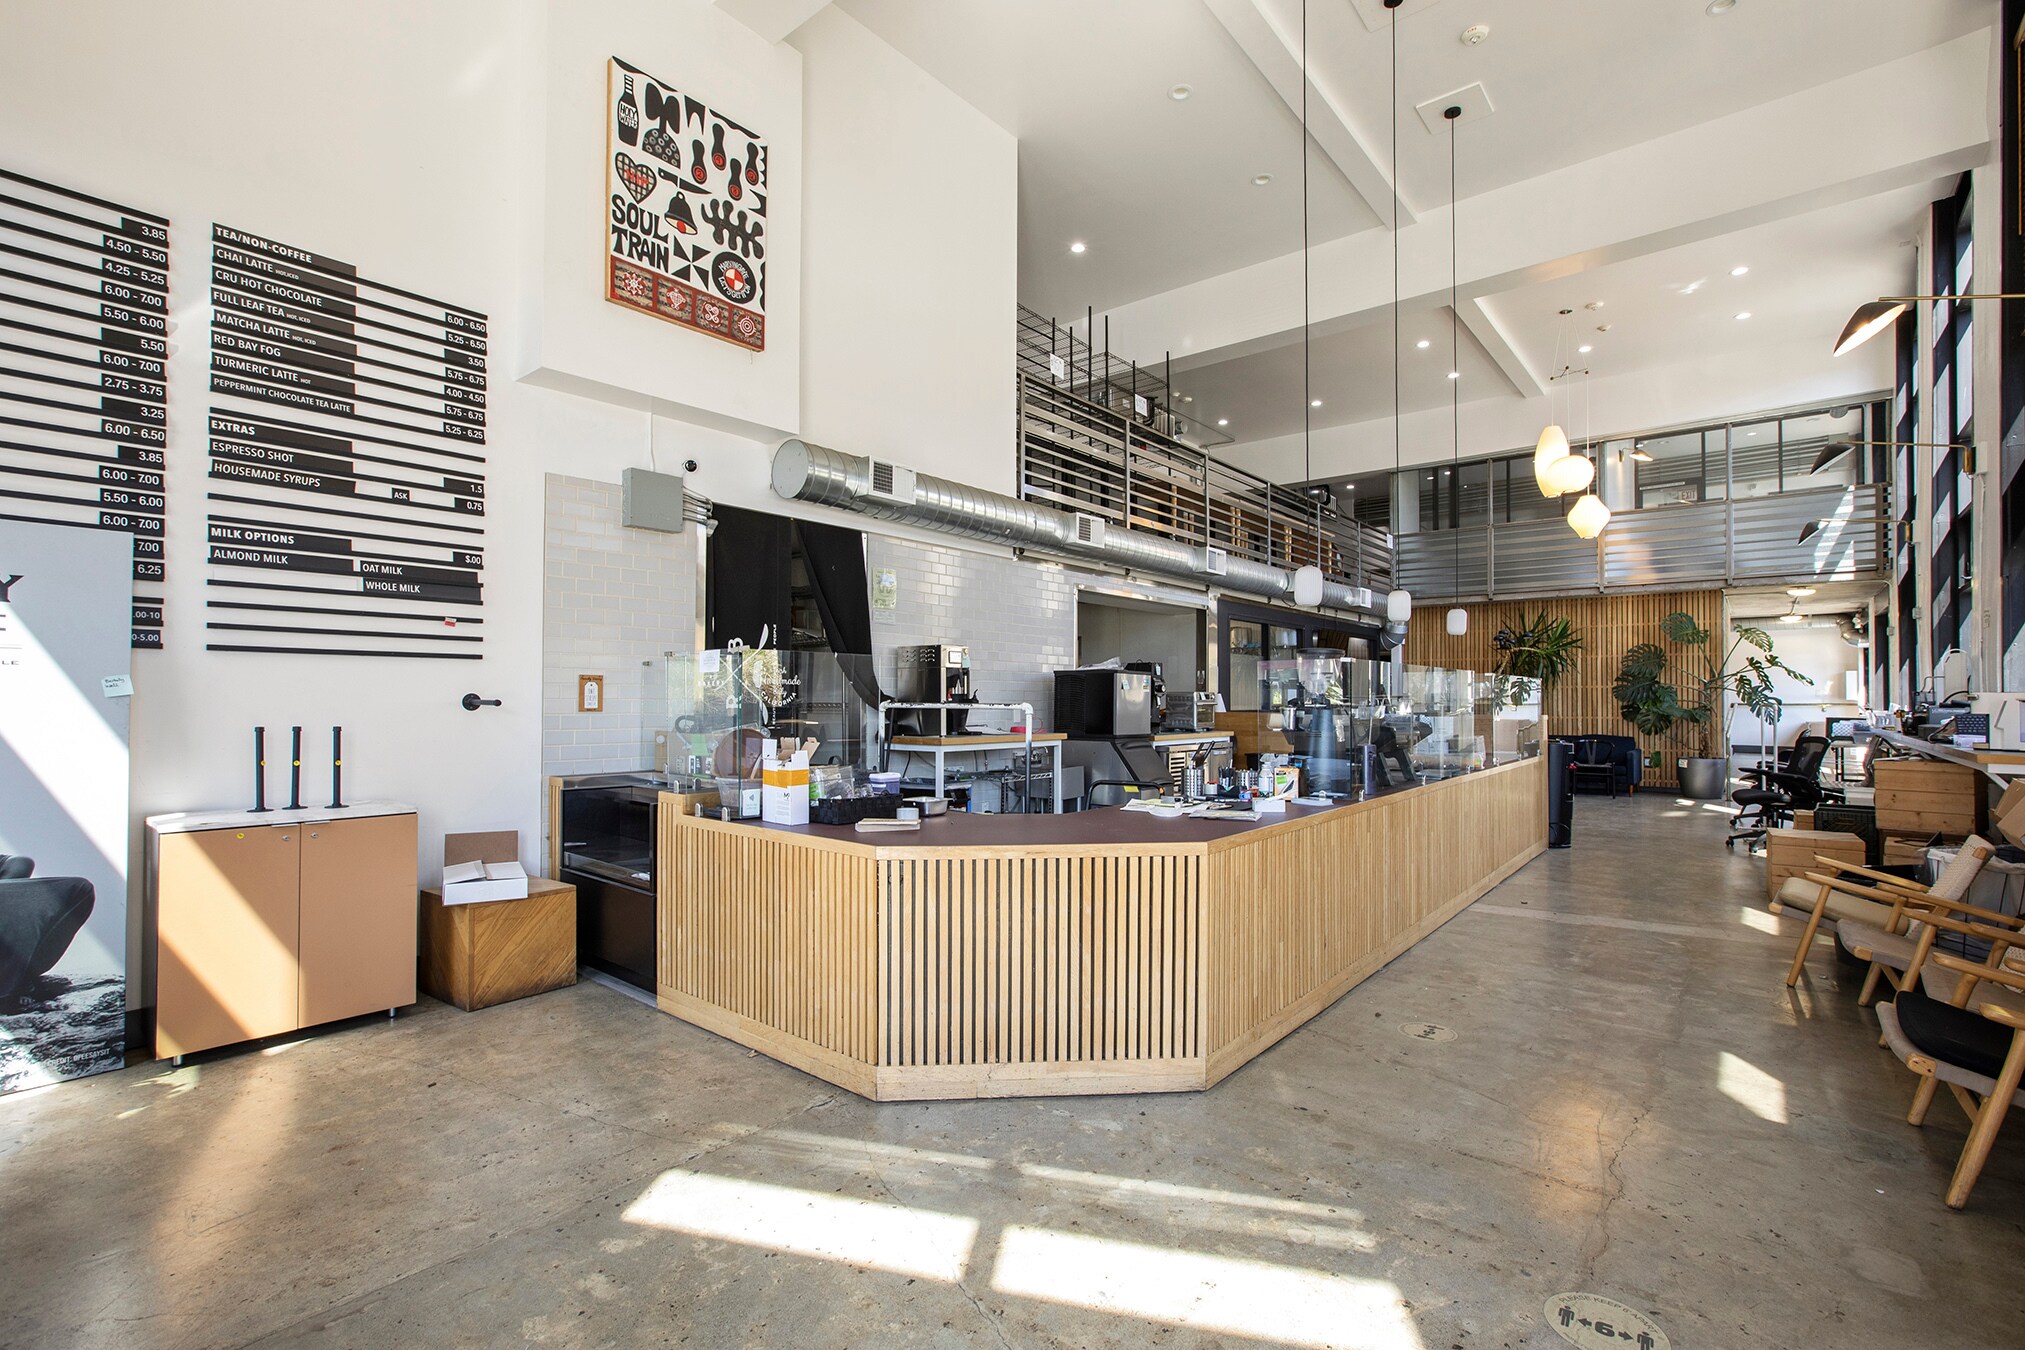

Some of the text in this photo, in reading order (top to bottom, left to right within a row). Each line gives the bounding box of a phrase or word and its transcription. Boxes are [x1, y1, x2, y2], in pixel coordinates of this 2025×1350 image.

[611, 194, 669, 244] SOUL
[141, 226, 166, 241] 3.85
[106, 239, 131, 254] 4.50
[142, 248, 166, 263] 5.50
[215, 226, 312, 264] TEA/NON-COFFEE
[611, 223, 669, 273] TRAIN
[216, 249, 243, 264] CHAI
[245, 256, 273, 273] LATTE
[105, 262, 130, 276] 4.25
[141, 270, 165, 285] 5.25
[105, 284, 130, 299] 6.00
[141, 293, 162, 307] 7.00
[215, 270, 322, 307] CRU HOT CHOCOLATE
[213, 291, 239, 305] FULL
[241, 297, 265, 312] LEAF
[266, 304, 285, 318] TEA
[104, 307, 129, 322] 5.50
[140, 315, 164, 329] 6.00
[216, 313, 261, 332] MATCHA
[263, 324, 290, 339] LATTE
[447, 314, 464, 327] 6.00
[470, 320, 486, 333] 6.50
[140, 339, 165, 352] 5.50
[214, 334, 281, 358] RED BAY FOG
[448, 333, 464, 346] 5.25
[470, 338, 486, 351] 6.50
[103, 354, 128, 367] 6.00
[139, 360, 161, 373] 7.00
[214, 355, 269, 376] TURMERIC
[271, 367, 299, 382] LATTE
[468, 356, 484, 368] 3.50
[448, 369, 463, 381] 5.75
[469, 374, 485, 386] 6.75
[104, 377, 129, 390] 2.75
[139, 382, 163, 397] 3.75
[214, 378, 351, 413] PEPPERMINT CHOCOLATE TEA LATTE
[446, 387, 463, 399] 4.00
[468, 392, 485, 404] 4.50
[140, 407, 165, 419] 3.25
[446, 405, 462, 417] 5.75
[468, 409, 484, 422] 6.75
[105, 423, 130, 436] 6.00
[140, 428, 165, 441] 6.50
[211, 420, 255, 436] EXTRAS
[445, 424, 462, 436] 5.25
[467, 428, 484, 440] 6.25
[138, 451, 163, 463] 3.85
[212, 441, 294, 463] ESPRESSO SHOT
[102, 469, 128, 481] 6.00
[138, 473, 159, 485] 7.00
[214, 463, 321, 488] HOUSEMADE SYRUPS
[394, 491, 408, 500] ASK
[470, 484, 483, 494] 1.5
[1681, 490, 1696, 500] EXIT
[103, 491, 129, 504] 5.50
[138, 496, 163, 508] 6.00
[467, 501, 483, 511] 0.75
[102, 514, 129, 527] 6.00
[138, 518, 160, 530] 7.00
[211, 527, 295, 545] MILK OPTIONS
[138, 541, 159, 552] 7.00
[213, 549, 288, 565] ALMOND MILK
[137, 564, 162, 575] 6.25
[362, 563, 403, 576] OAT MILK
[365, 581, 421, 594] WHOLE MILK
[760, 690, 797, 707] CALIFORNIA
[1558, 1294, 1591, 1303] PLEASE
[1593, 1297, 1622, 1309] KEEP
[1633, 1313, 1659, 1334] APART
[1594, 1321, 1616, 1338] 6
